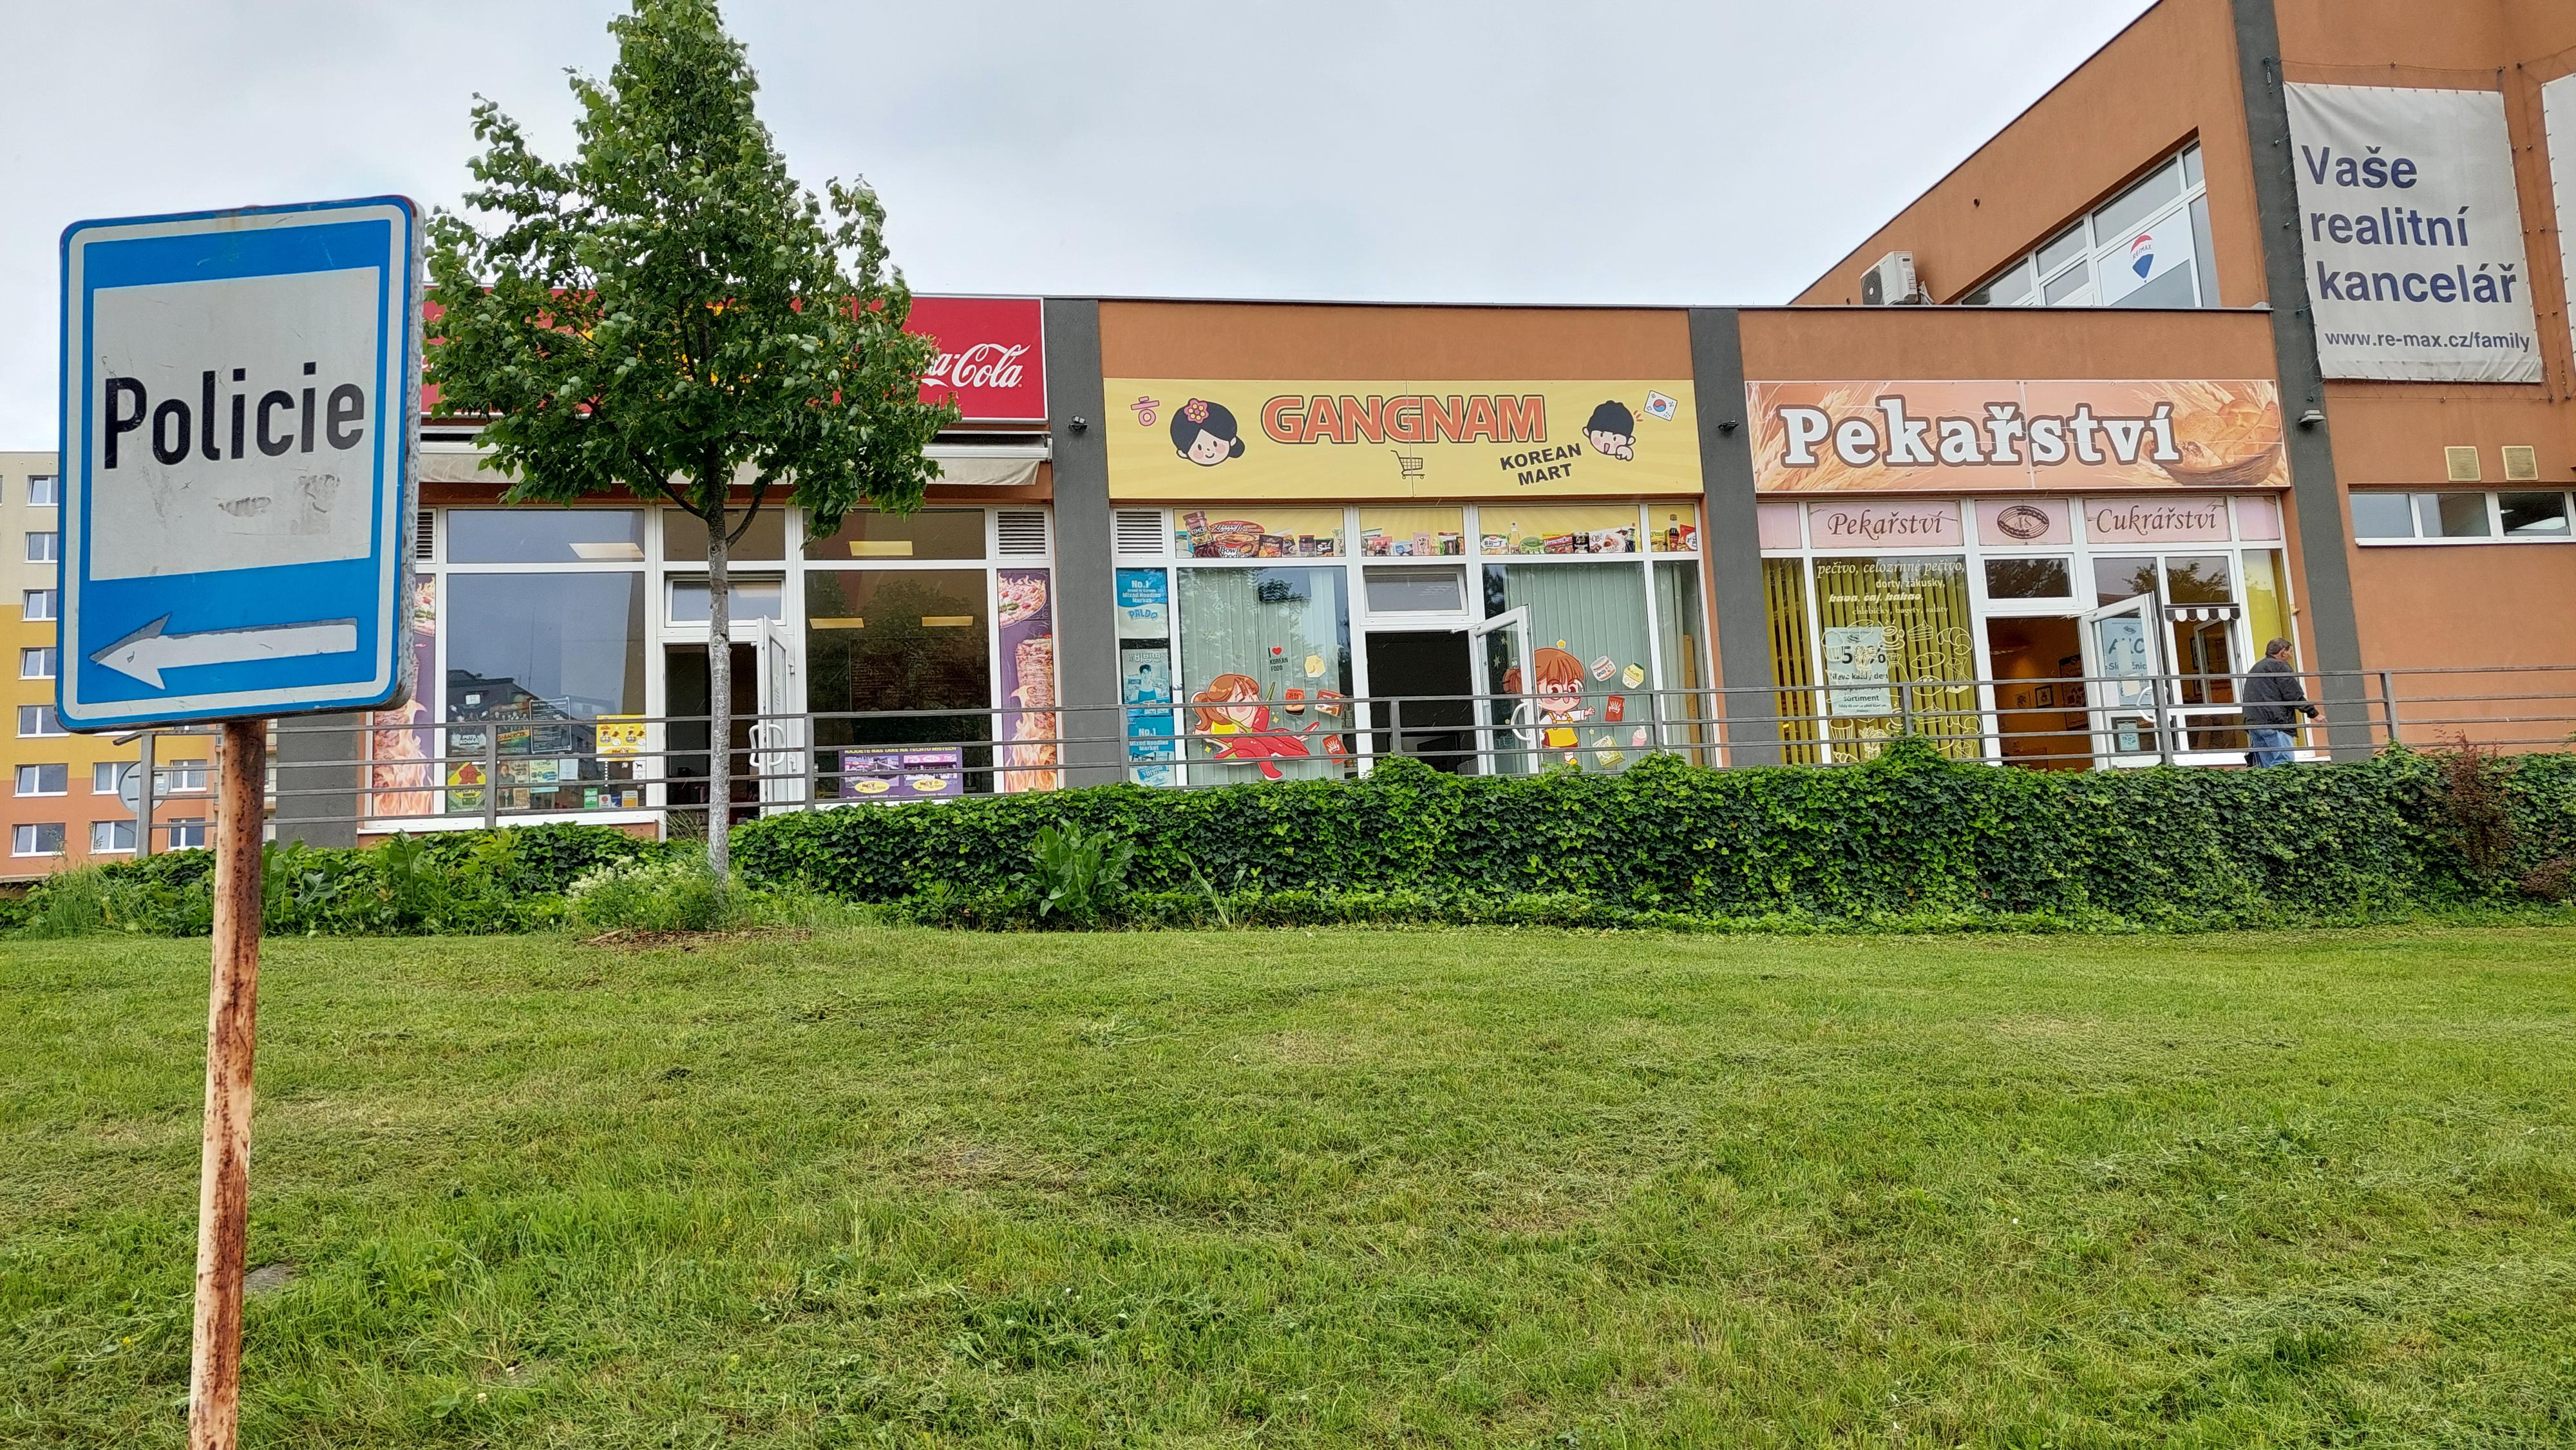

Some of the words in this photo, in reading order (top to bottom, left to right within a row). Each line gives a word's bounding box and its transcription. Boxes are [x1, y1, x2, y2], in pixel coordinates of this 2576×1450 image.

[2301, 145, 2417, 189] Vaše
[2311, 206, 2469, 246] realitní
[2316, 261, 2517, 303] kancelář
[2324, 332, 2531, 353] www.re-max.cz/family
[104, 361, 365, 469] Policie
[1261, 394, 1547, 444] GANGNAM
[1777, 395, 2183, 468] Pekařství
[1500, 443, 1582, 471] KOREAN
[1517, 463, 1571, 486] MART
[1828, 509, 1944, 541] Pekařství
[2097, 505, 2217, 536] Cukrářství
[1817, 561, 1859, 578] pečivo,
[1863, 559, 1921, 573] celozrnné
[1924, 561, 1965, 576] pečivo,
[1875, 579, 1903, 589] dorty,
[1905, 578, 1946, 588] zákusky,
[1925, 603, 1949, 615] saláty
[1269, 657, 1289, 666] KOREAN
[1138, 728, 1156, 737] No.1
